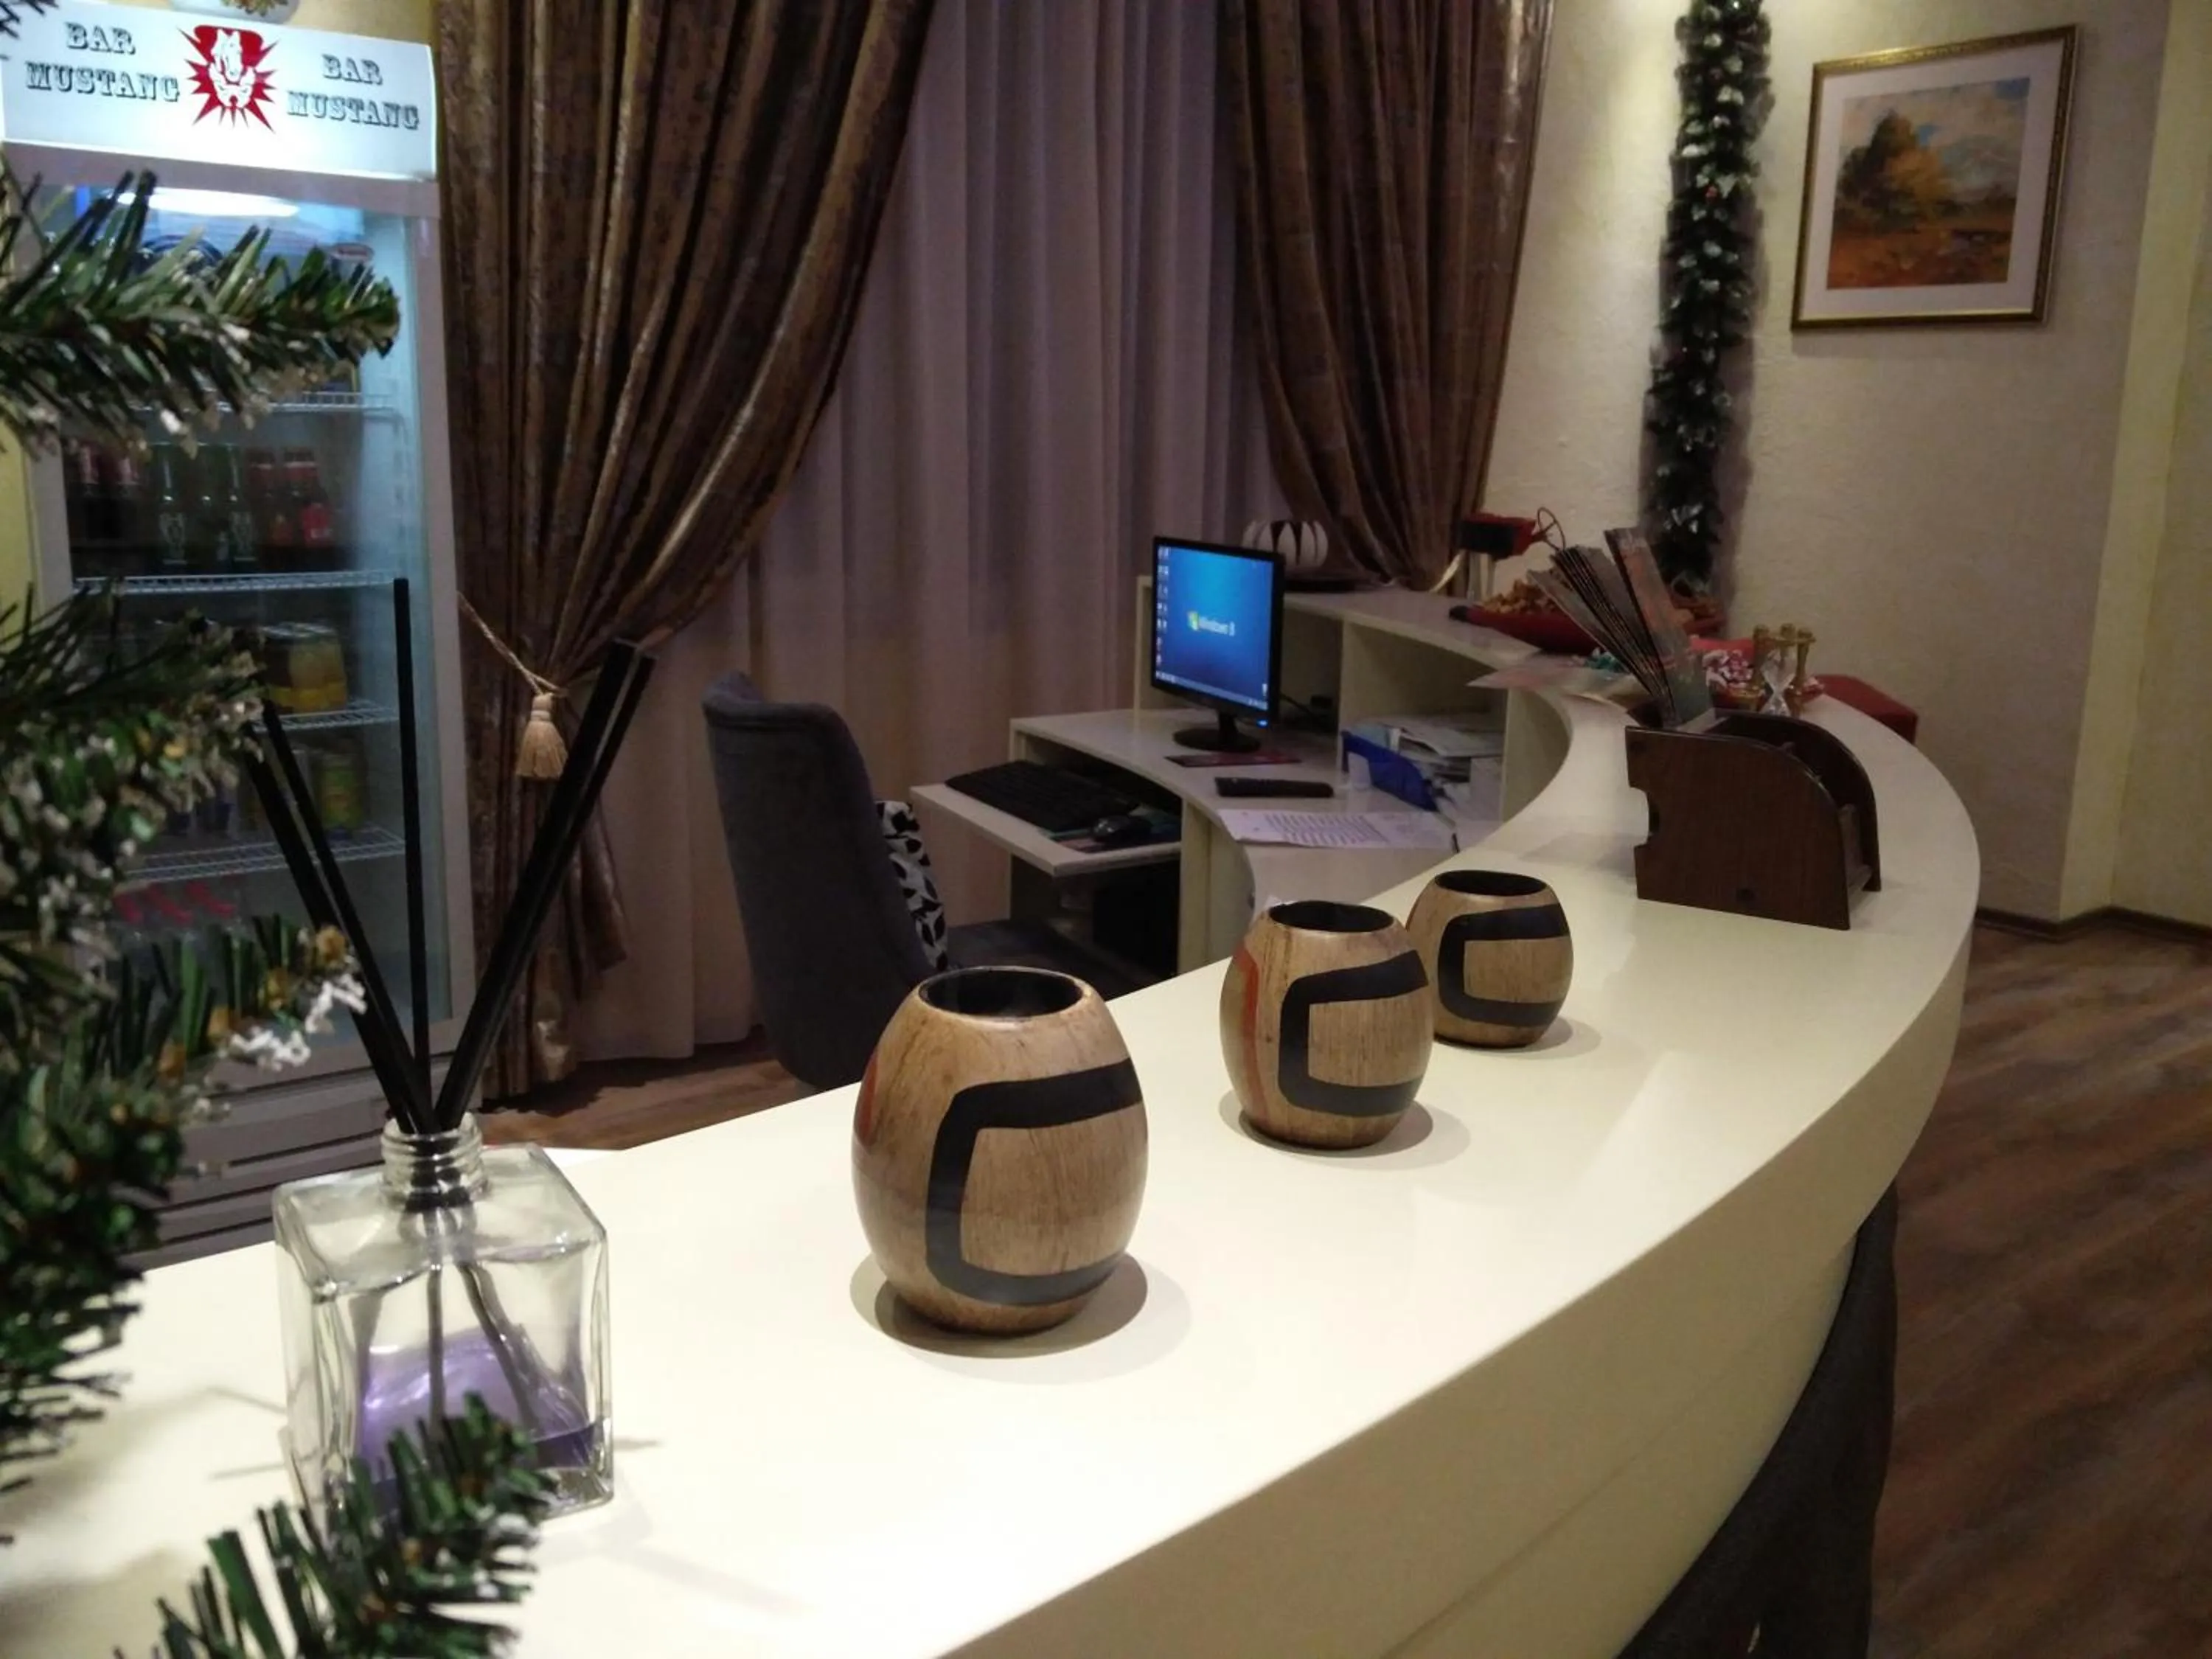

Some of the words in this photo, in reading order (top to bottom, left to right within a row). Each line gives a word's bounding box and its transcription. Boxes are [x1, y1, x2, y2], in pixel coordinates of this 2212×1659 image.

[65, 21, 136, 55] BAR
[25, 61, 180, 102] MUSTANG
[321, 54, 383, 85] BAR
[287, 91, 420, 130] MUSTANG
